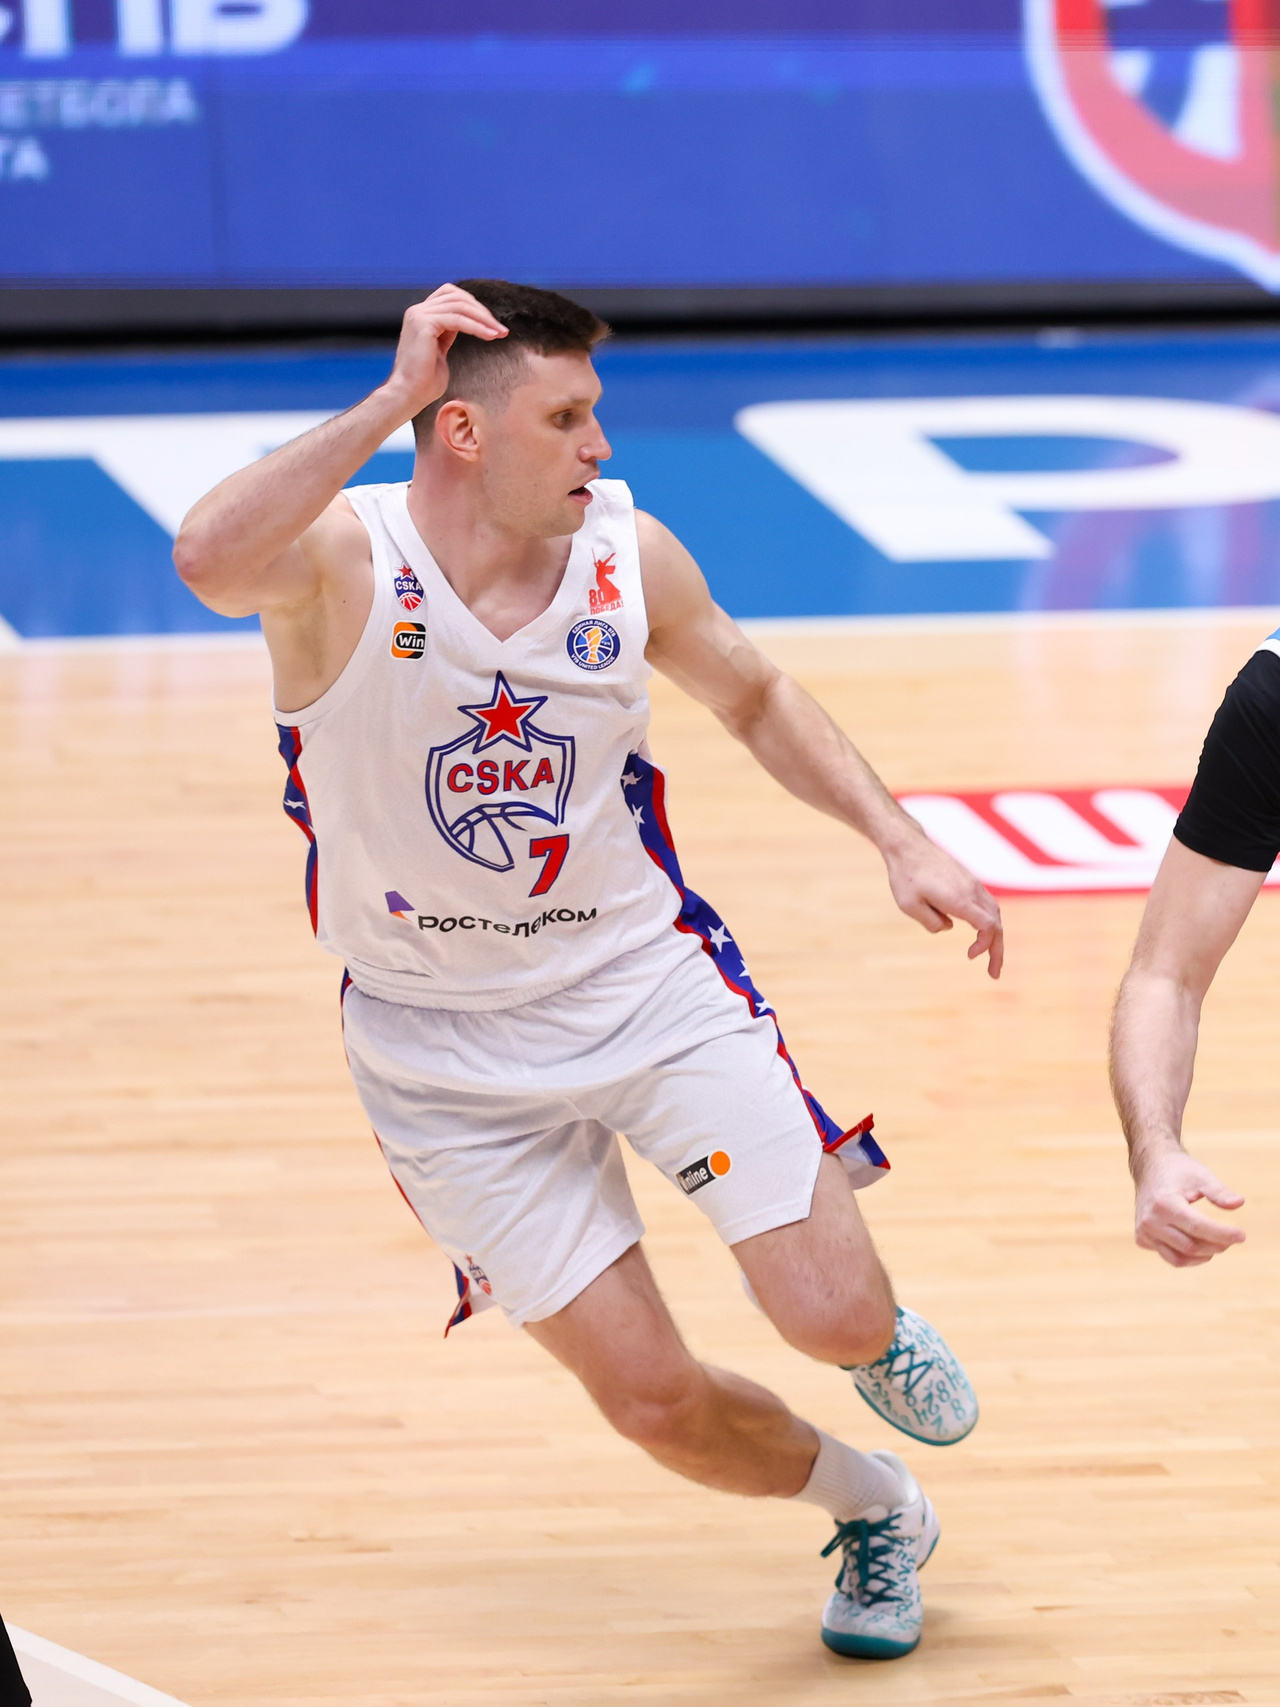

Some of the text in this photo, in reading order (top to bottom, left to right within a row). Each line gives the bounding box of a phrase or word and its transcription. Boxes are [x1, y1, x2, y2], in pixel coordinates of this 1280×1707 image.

[395, 580, 423, 592] CSKA
[590, 599, 624, 616] ПОБЕДА!
[594, 621, 609, 630] ЛИГА
[398, 634, 425, 648] Win
[578, 661, 598, 670] UNITED
[597, 656, 616, 669] LEAGUE
[447, 757, 555, 795] CSKA
[528, 833, 570, 898] 7
